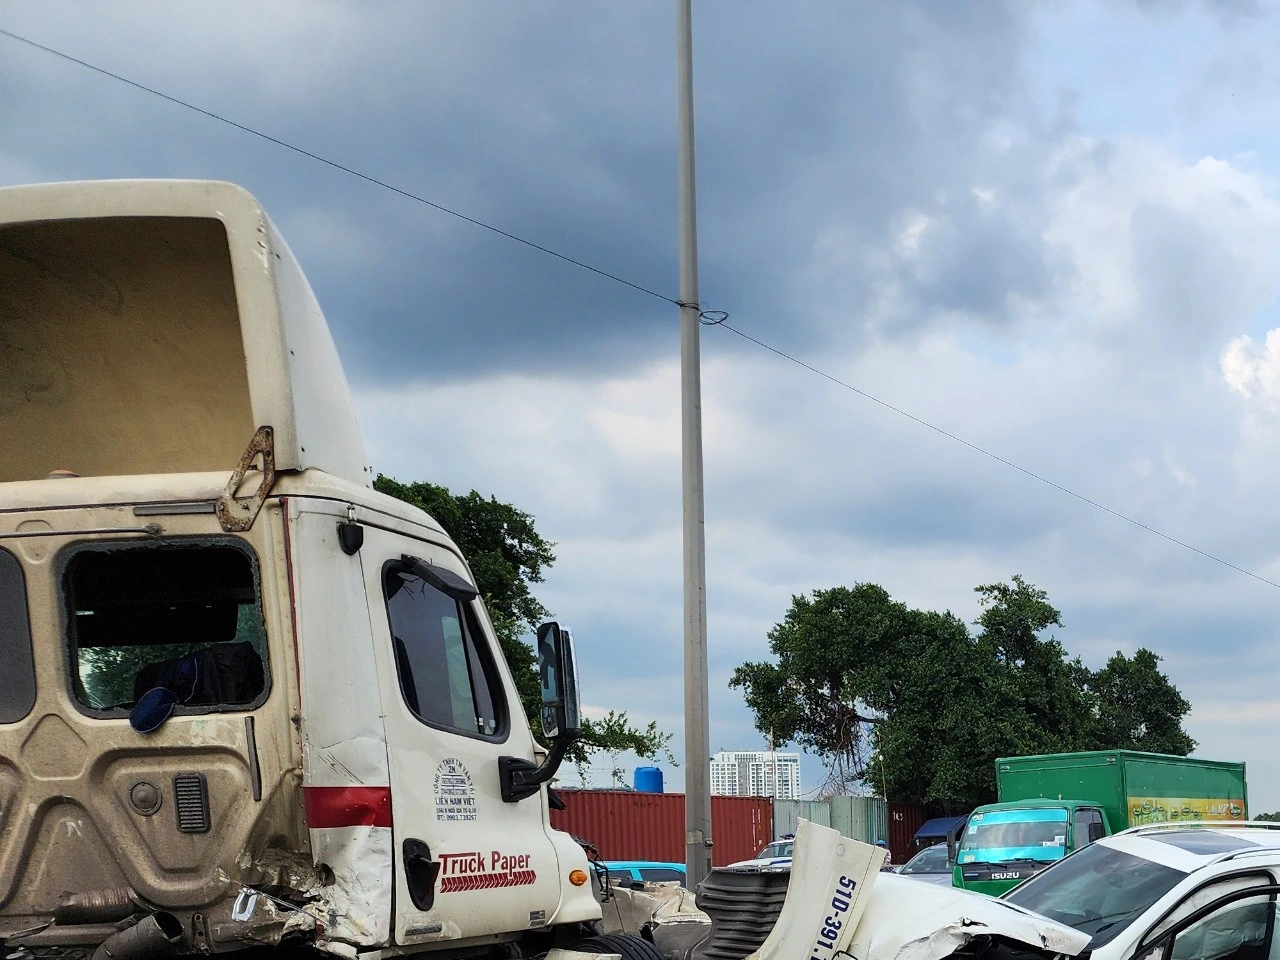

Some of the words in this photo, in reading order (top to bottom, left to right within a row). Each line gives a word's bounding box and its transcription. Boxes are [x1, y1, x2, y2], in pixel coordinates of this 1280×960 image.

[449, 797, 462, 806] NAM
[438, 851, 486, 875] Truck
[491, 850, 531, 879] Paper
[991, 872, 1020, 880] ISUZU
